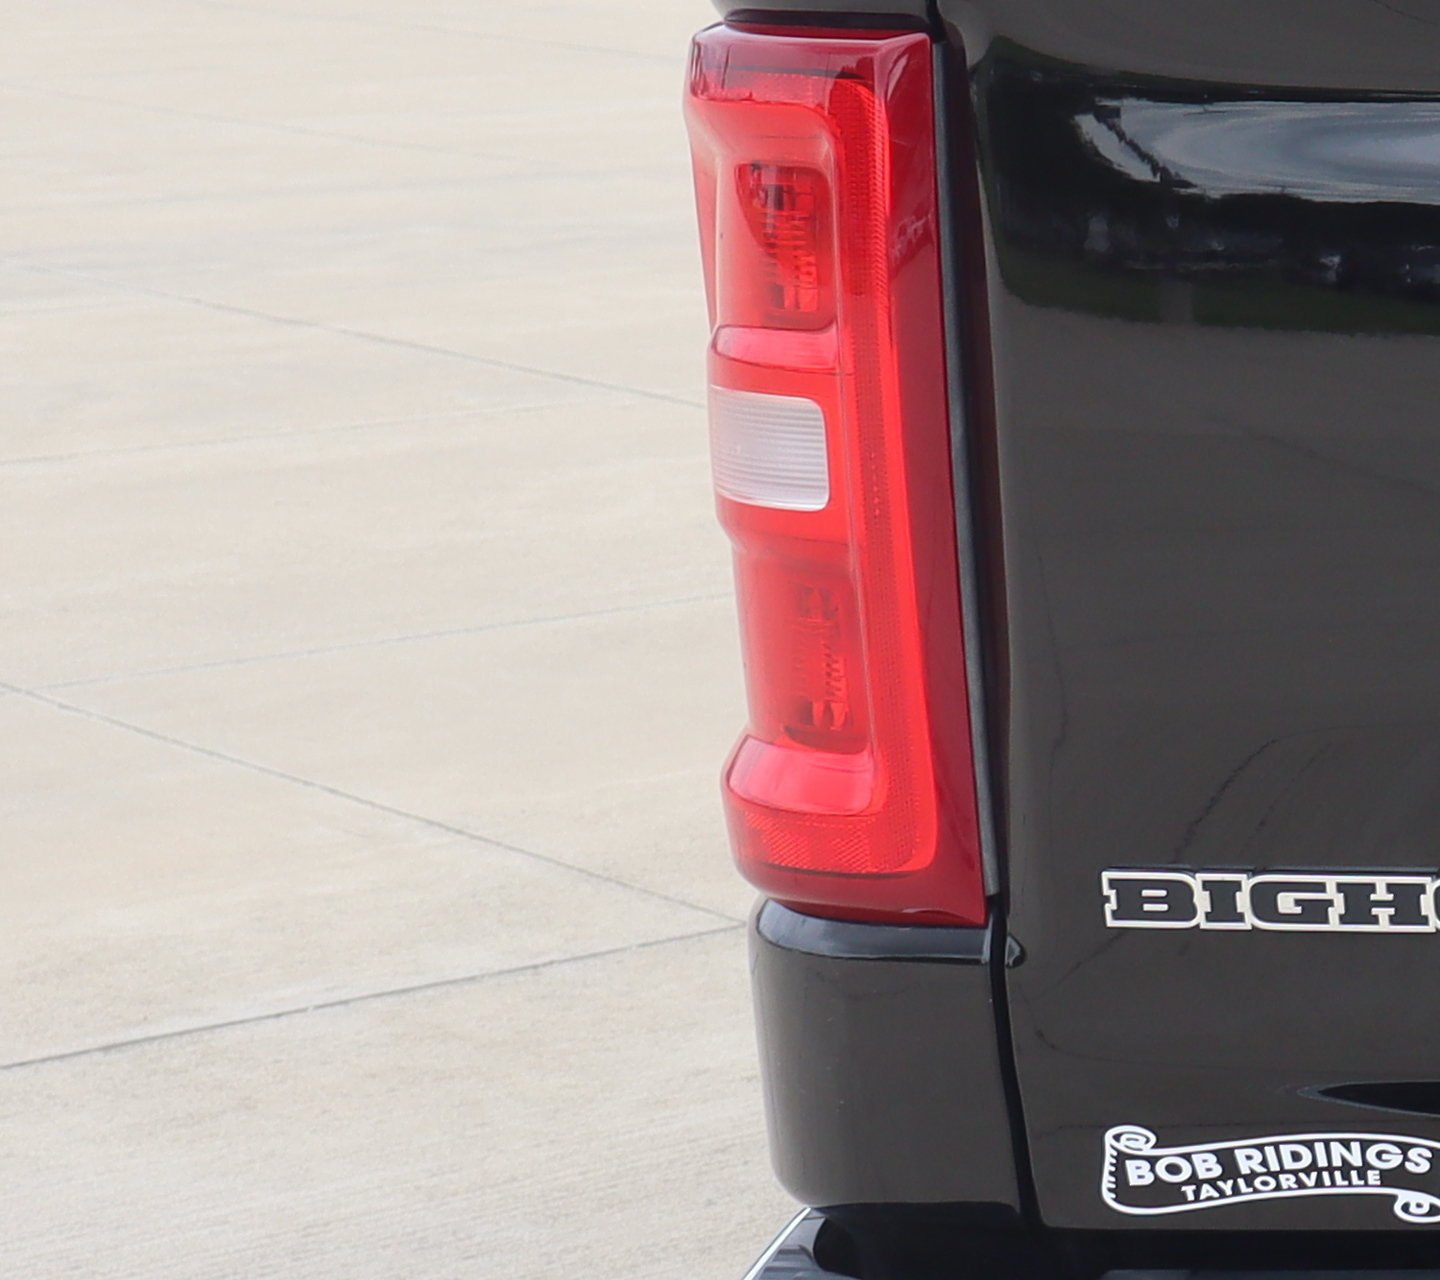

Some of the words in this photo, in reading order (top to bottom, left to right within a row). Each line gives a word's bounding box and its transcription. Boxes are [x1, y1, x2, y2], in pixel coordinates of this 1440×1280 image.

[1124, 1152, 1223, 1187] BOB
[1233, 1141, 1433, 1175] RIDINGS
[1180, 1169, 1382, 1202] TAYLORVILLE
